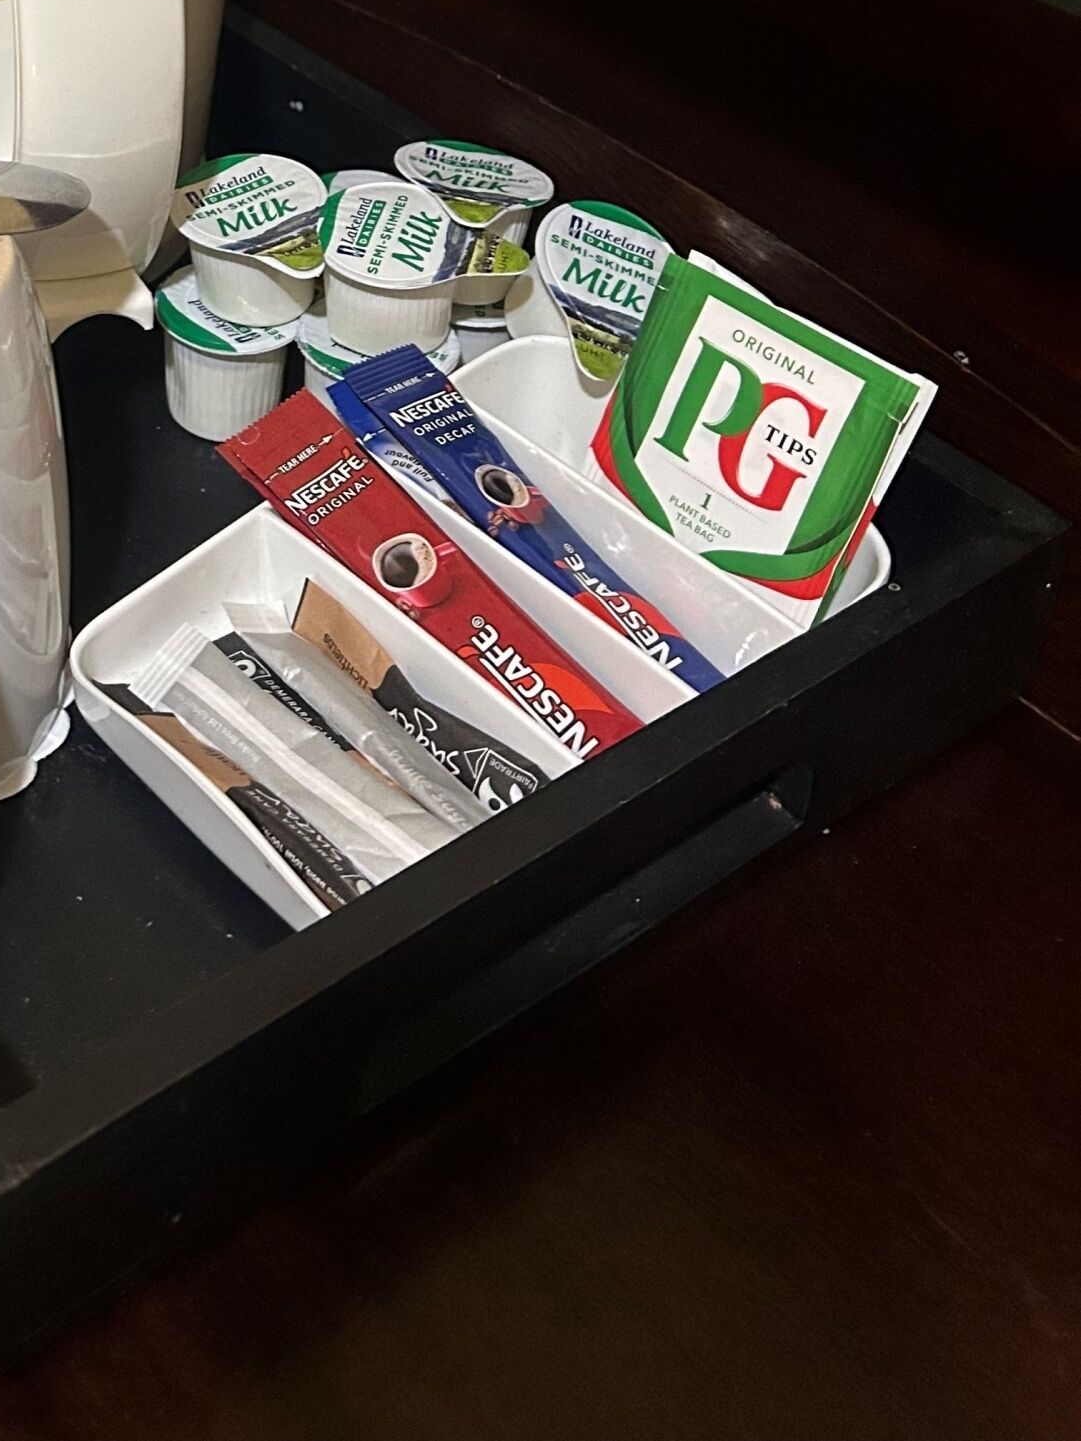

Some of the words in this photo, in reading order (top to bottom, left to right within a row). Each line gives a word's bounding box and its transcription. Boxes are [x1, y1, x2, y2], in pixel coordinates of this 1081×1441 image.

[441, 151, 514, 169] Lakeland
[201, 166, 267, 197] Lakeland
[209, 177, 270, 203] DAIRIES
[425, 170, 511, 193] Milk
[185, 180, 296, 221] SEMI-SKIMMED
[216, 197, 298, 237] Milk
[345, 197, 373, 245] Lakeland
[360, 201, 385, 246] DAIRIES
[367, 195, 409, 275] SEMI-SKIMMED
[392, 211, 443, 272] Milk
[584, 221, 656, 259] Lakeland
[586, 236, 651, 268] DAIRIES
[550, 234, 658, 287] SEMI-SKIMME
[562, 258, 646, 313] Milk
[187, 299, 241, 338] Lakeland
[580, 345, 606, 360] UHT
[732, 329, 814, 385] ORIGINAL
[384, 381, 404, 394] TEAR
[413, 408, 473, 436] ORIGINAL
[435, 423, 476, 445] DECAF
[653, 336, 828, 511] PG
[278, 457, 300, 474] TEAR
[296, 444, 319, 465] HERE
[765, 424, 817, 466] TIPS
[392, 459, 414, 472] and
[412, 466, 434, 483] Full
[308, 475, 374, 526] ORIGINAL
[669, 494, 700, 519] PLANT
[699, 511, 732, 539] BASED
[700, 493, 712, 511] 1
[675, 512, 695, 531] TEA
[694, 524, 715, 543] BAG
[264, 679, 312, 724] DEMERARA
[206, 715, 223, 732] Ltd
[487, 757, 533, 790] FAIRTRADE
